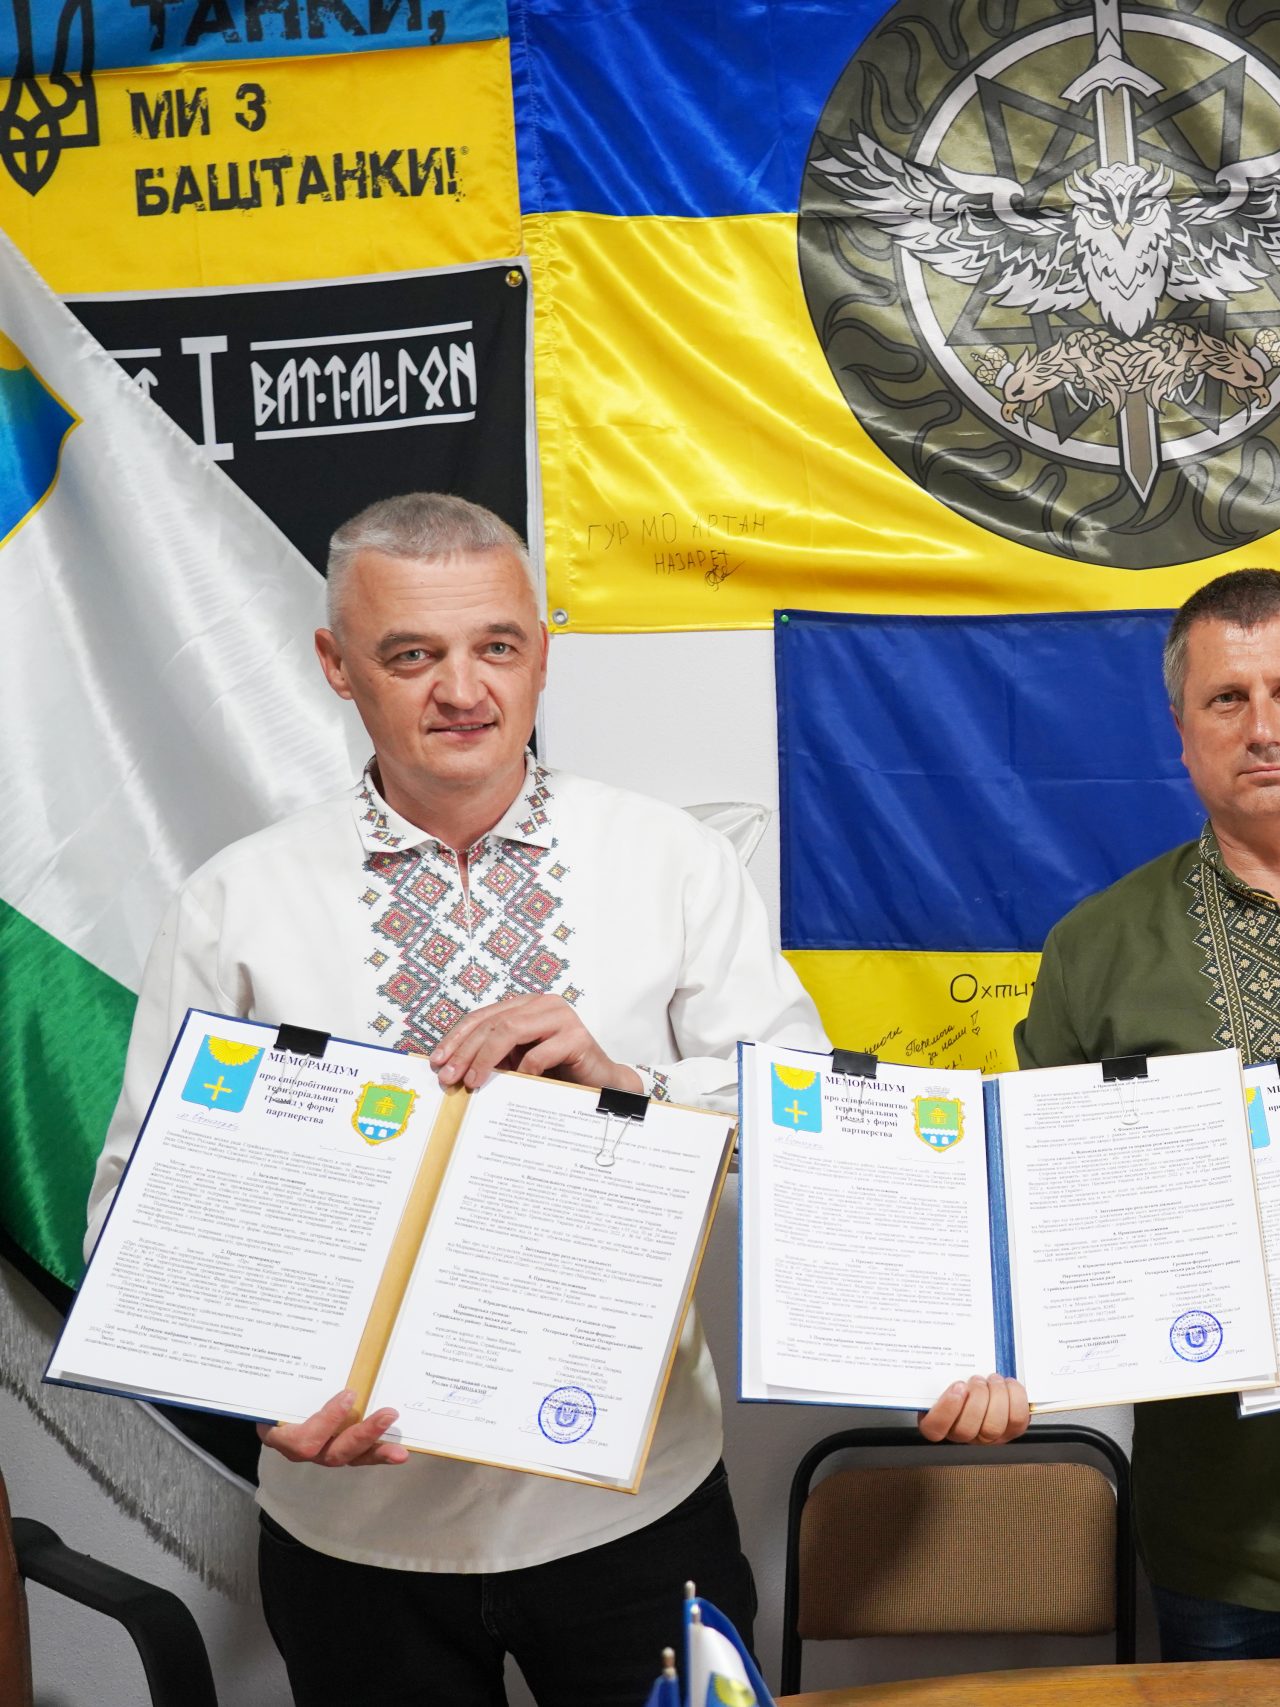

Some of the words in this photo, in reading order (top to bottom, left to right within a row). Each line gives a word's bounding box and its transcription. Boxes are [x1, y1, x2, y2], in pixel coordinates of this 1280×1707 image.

[127, 87, 210, 141] МИ
[134, 147, 460, 218] БАШТАНКИ!
[587, 520, 629, 551] ГУР
[642, 512, 677, 545] МО
[692, 513, 767, 540] АРТАН
[950, 973, 1037, 1004] Охти
[268, 1052, 360, 1078] МЕМОРАНДУМ
[259, 1072, 276, 1083] про
[825, 1075, 905, 1093] МЕМОРАНДУМ
[824, 1095, 839, 1104] про
[266, 1108, 325, 1126] партнерства
[841, 1126, 893, 1138] партнерства
